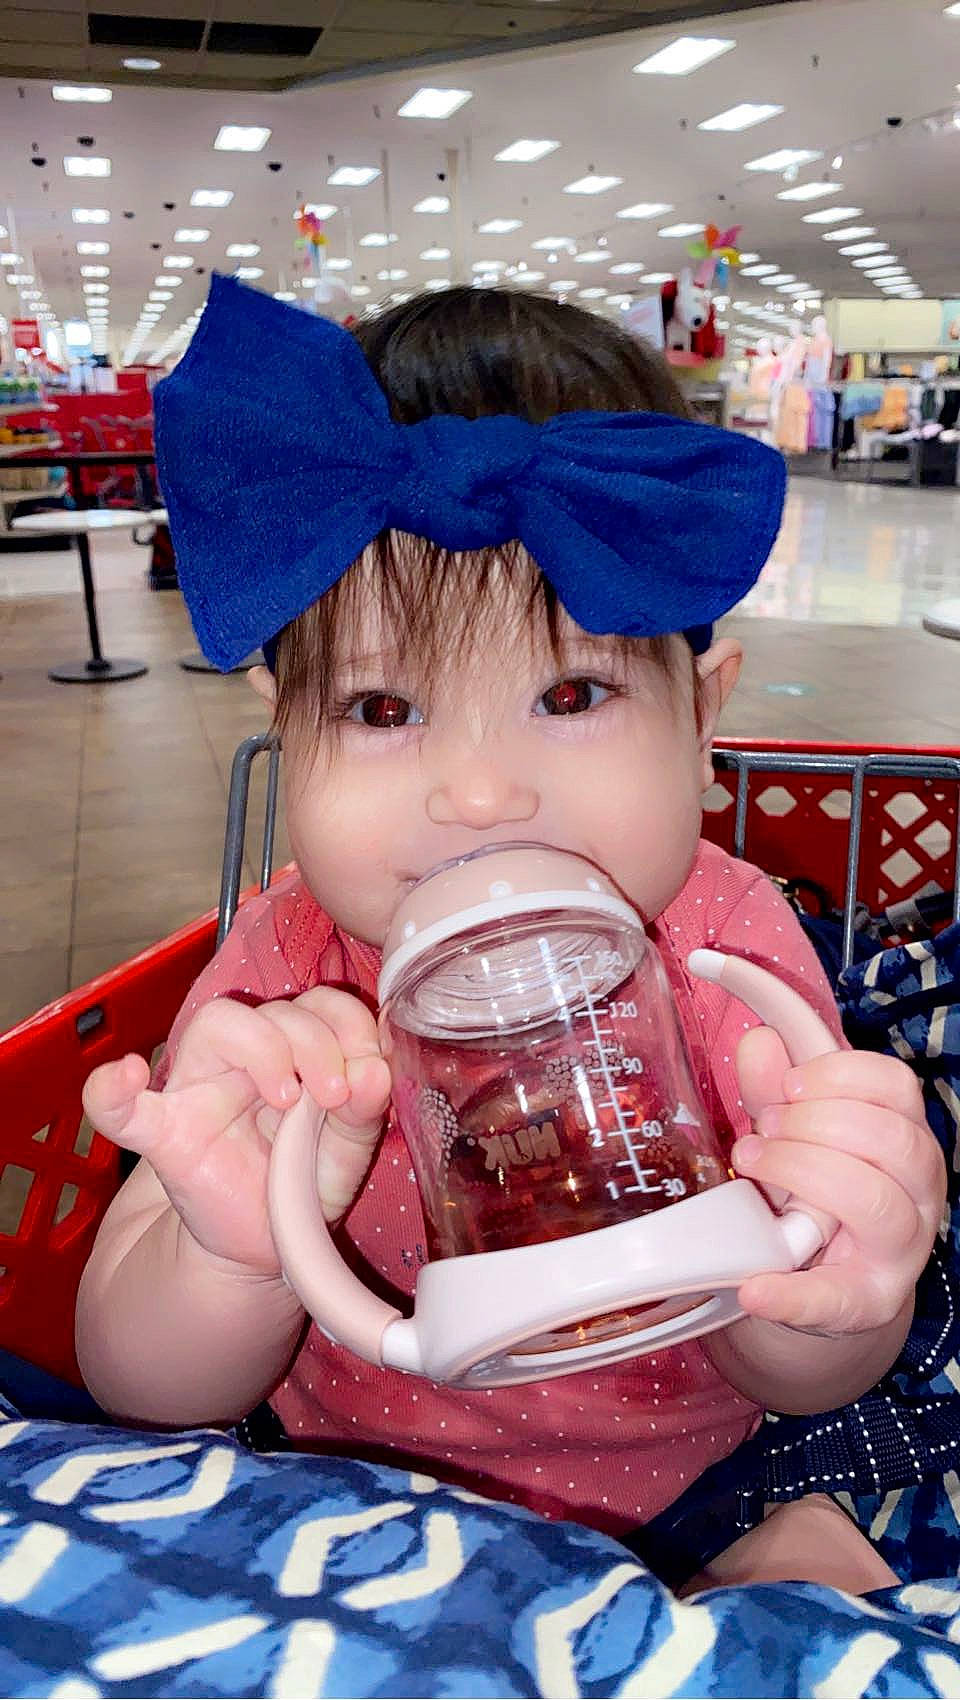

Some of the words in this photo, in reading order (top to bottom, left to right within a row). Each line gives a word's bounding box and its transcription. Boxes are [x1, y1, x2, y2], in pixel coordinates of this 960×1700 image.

[609, 999, 638, 1019] 120
[621, 1056, 644, 1075] 90
[588, 1127, 606, 1148] 2
[641, 1119, 663, 1138] 60
[605, 1180, 620, 1201] 1
[660, 1177, 688, 1197] 30
